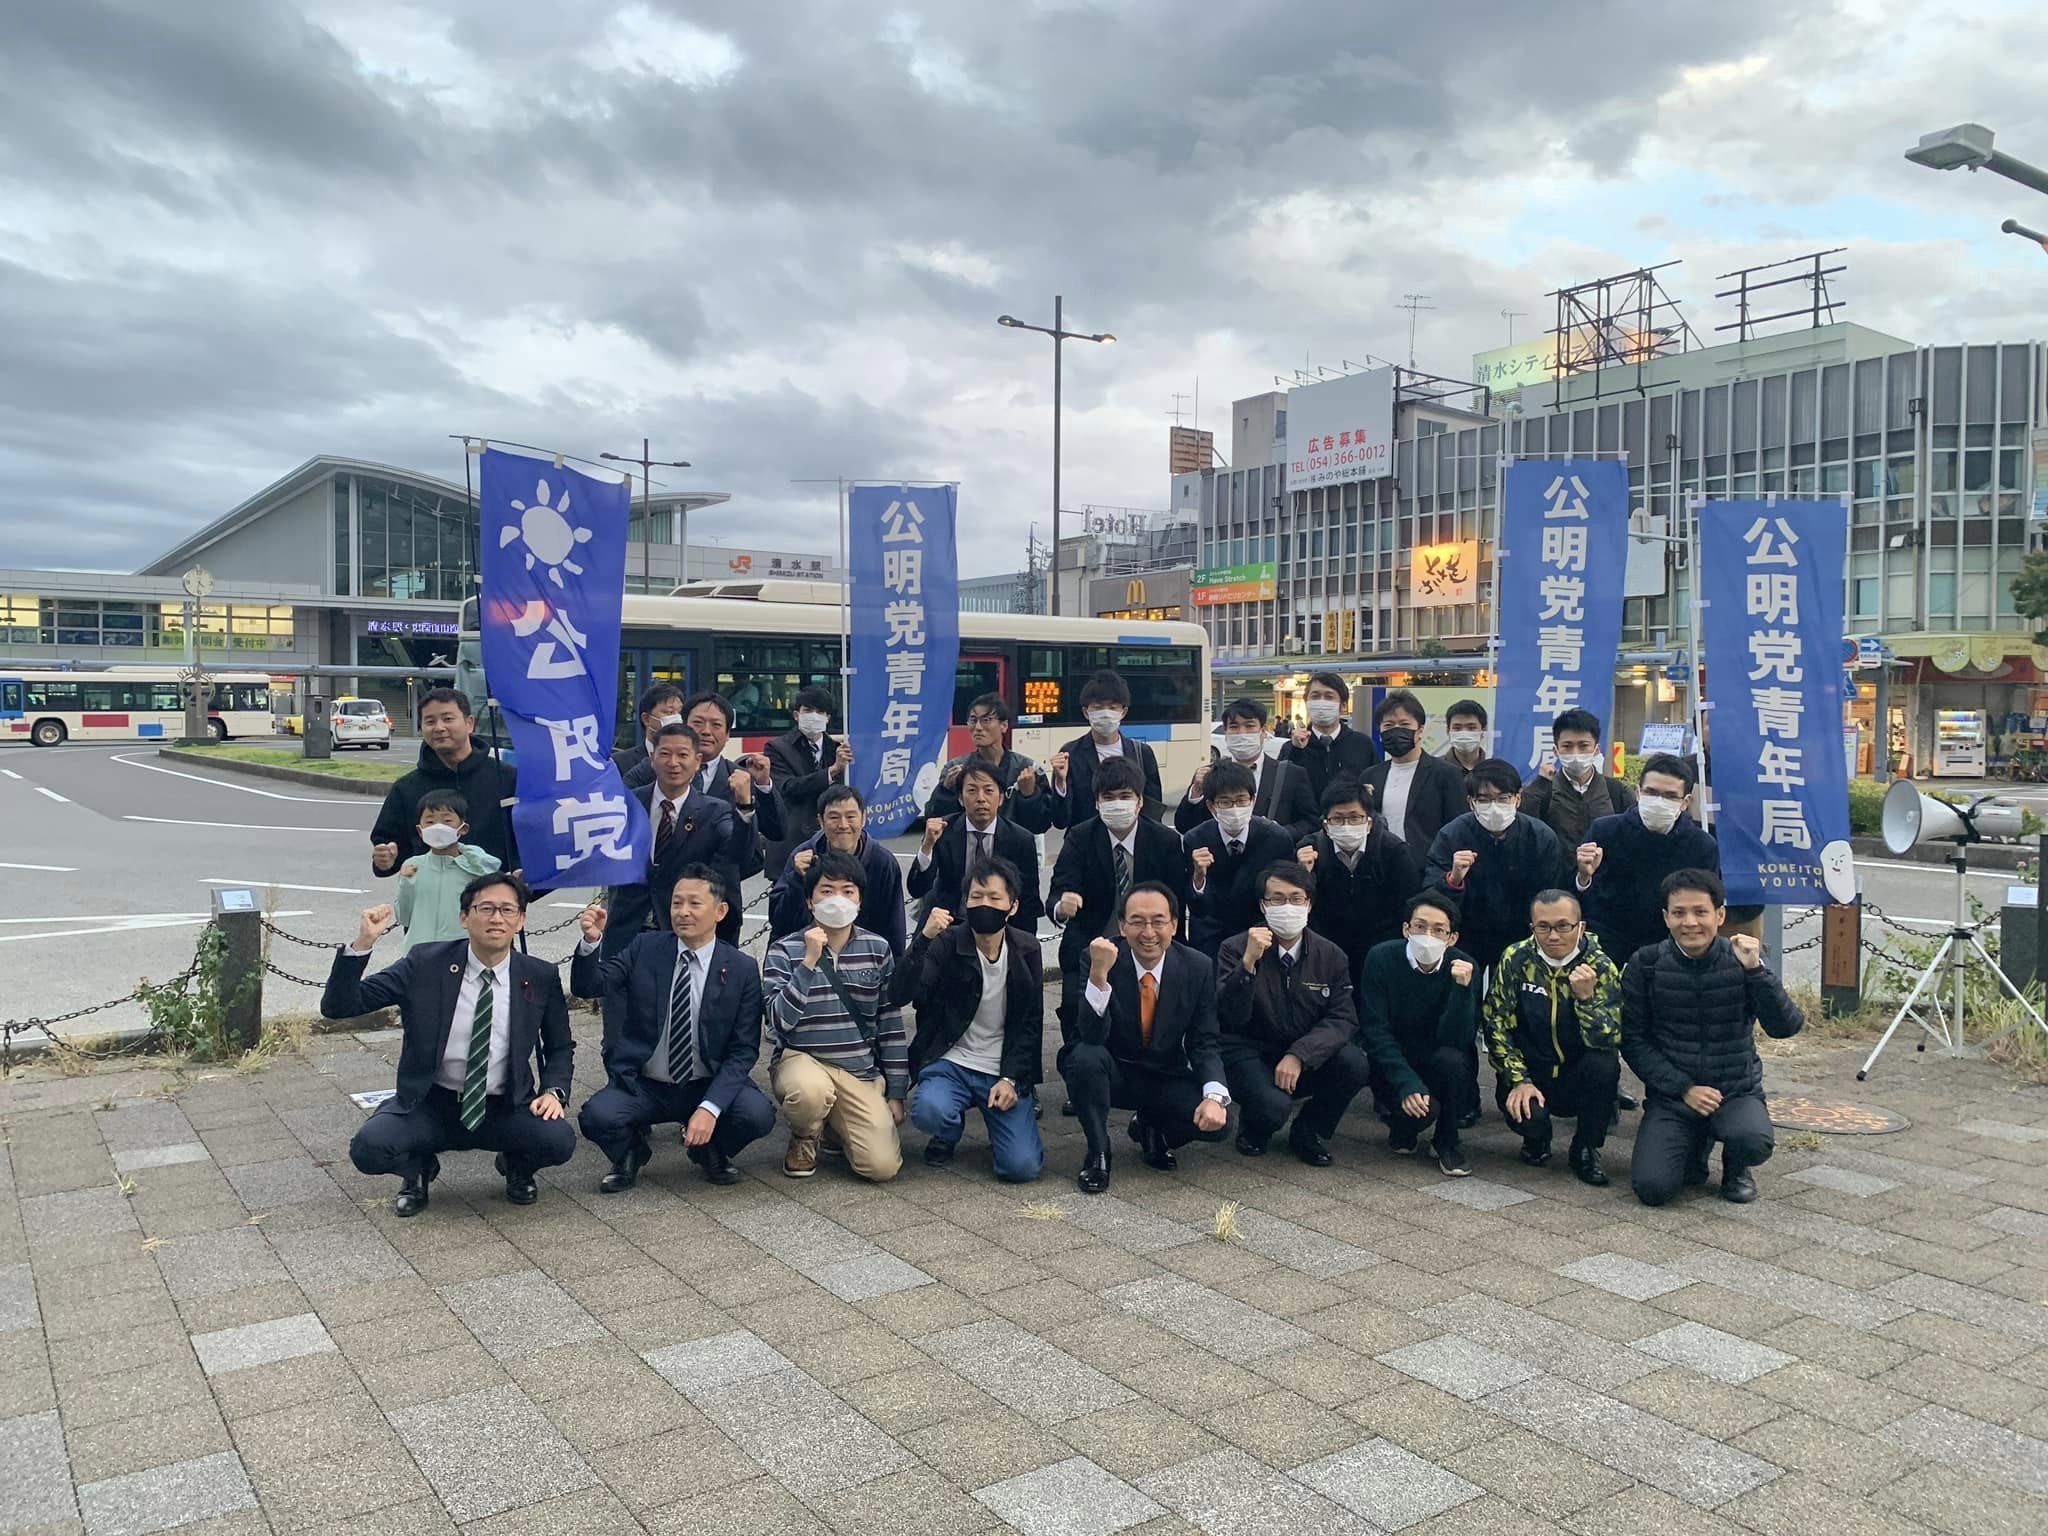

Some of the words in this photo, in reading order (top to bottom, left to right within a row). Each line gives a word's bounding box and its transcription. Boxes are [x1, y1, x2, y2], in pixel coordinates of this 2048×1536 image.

[1308, 429, 1367, 454] 広告募集
[729, 555, 752, 570] JR
[1196, 574, 1206, 583] 2F
[1197, 591, 1206, 600] 1F
[881, 500, 927, 789] 公明党青年局
[1743, 517, 1812, 850] 公明党青年局
[1758, 863, 1823, 876] KOMEITO
[1759, 876, 1824, 889] YOUTH
